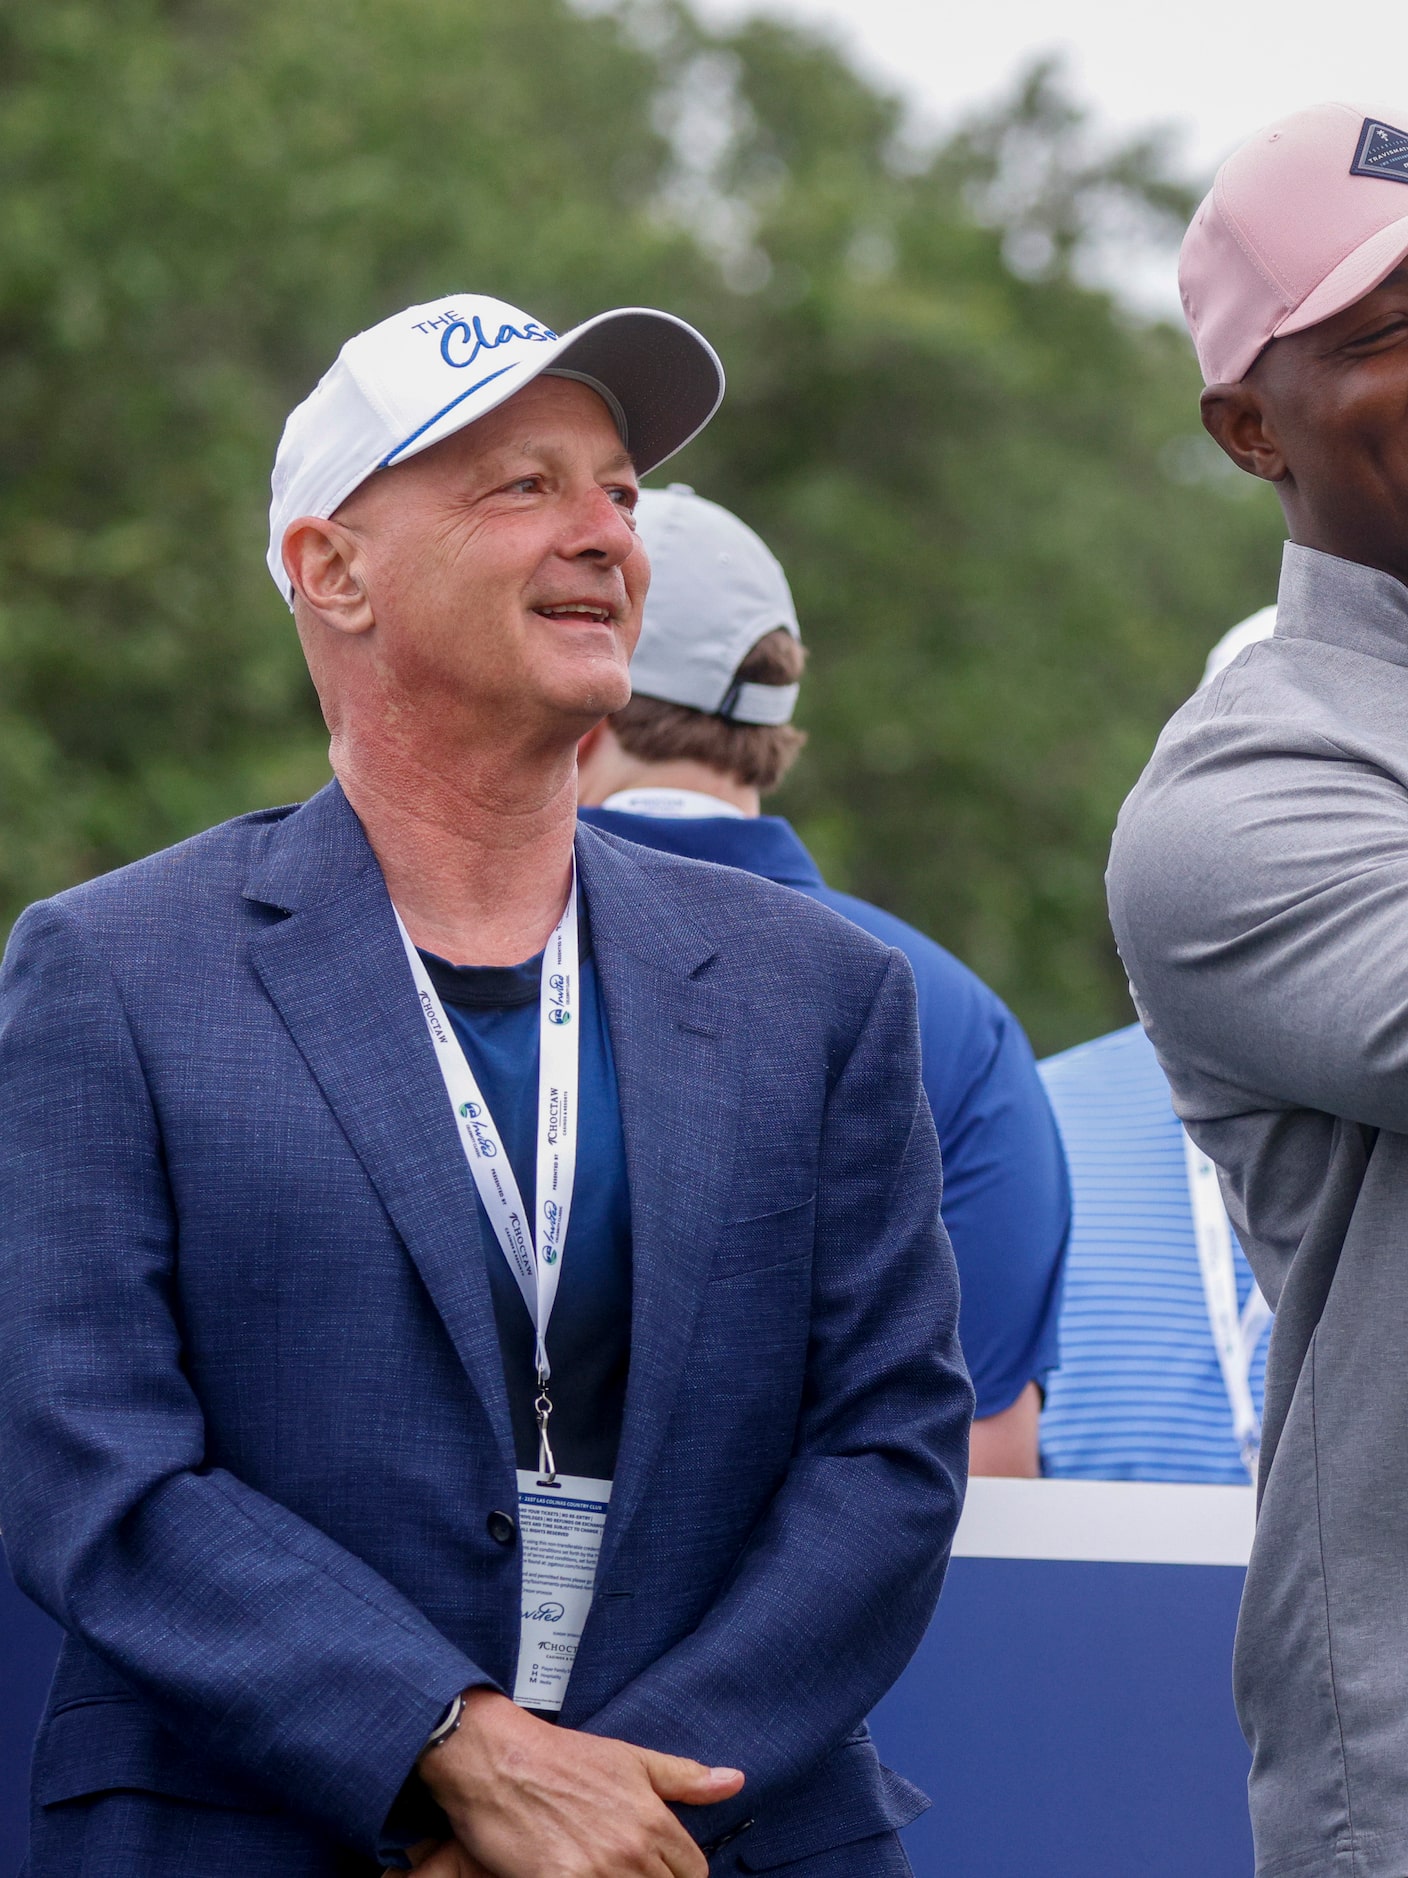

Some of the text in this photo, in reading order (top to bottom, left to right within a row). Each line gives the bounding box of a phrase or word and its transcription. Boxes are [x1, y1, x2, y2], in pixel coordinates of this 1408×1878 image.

[411, 310, 465, 334] THE
[549, 974, 565, 1007] Invited
[419, 990, 448, 1044] CHOCTAW
[547, 1087, 559, 1146] CHOCTAW
[470, 1121, 497, 1157] Invited
[543, 1200, 557, 1244] Invited
[509, 1212, 533, 1276] CHOCTAW
[566, 1501, 589, 1509] COUNTRY
